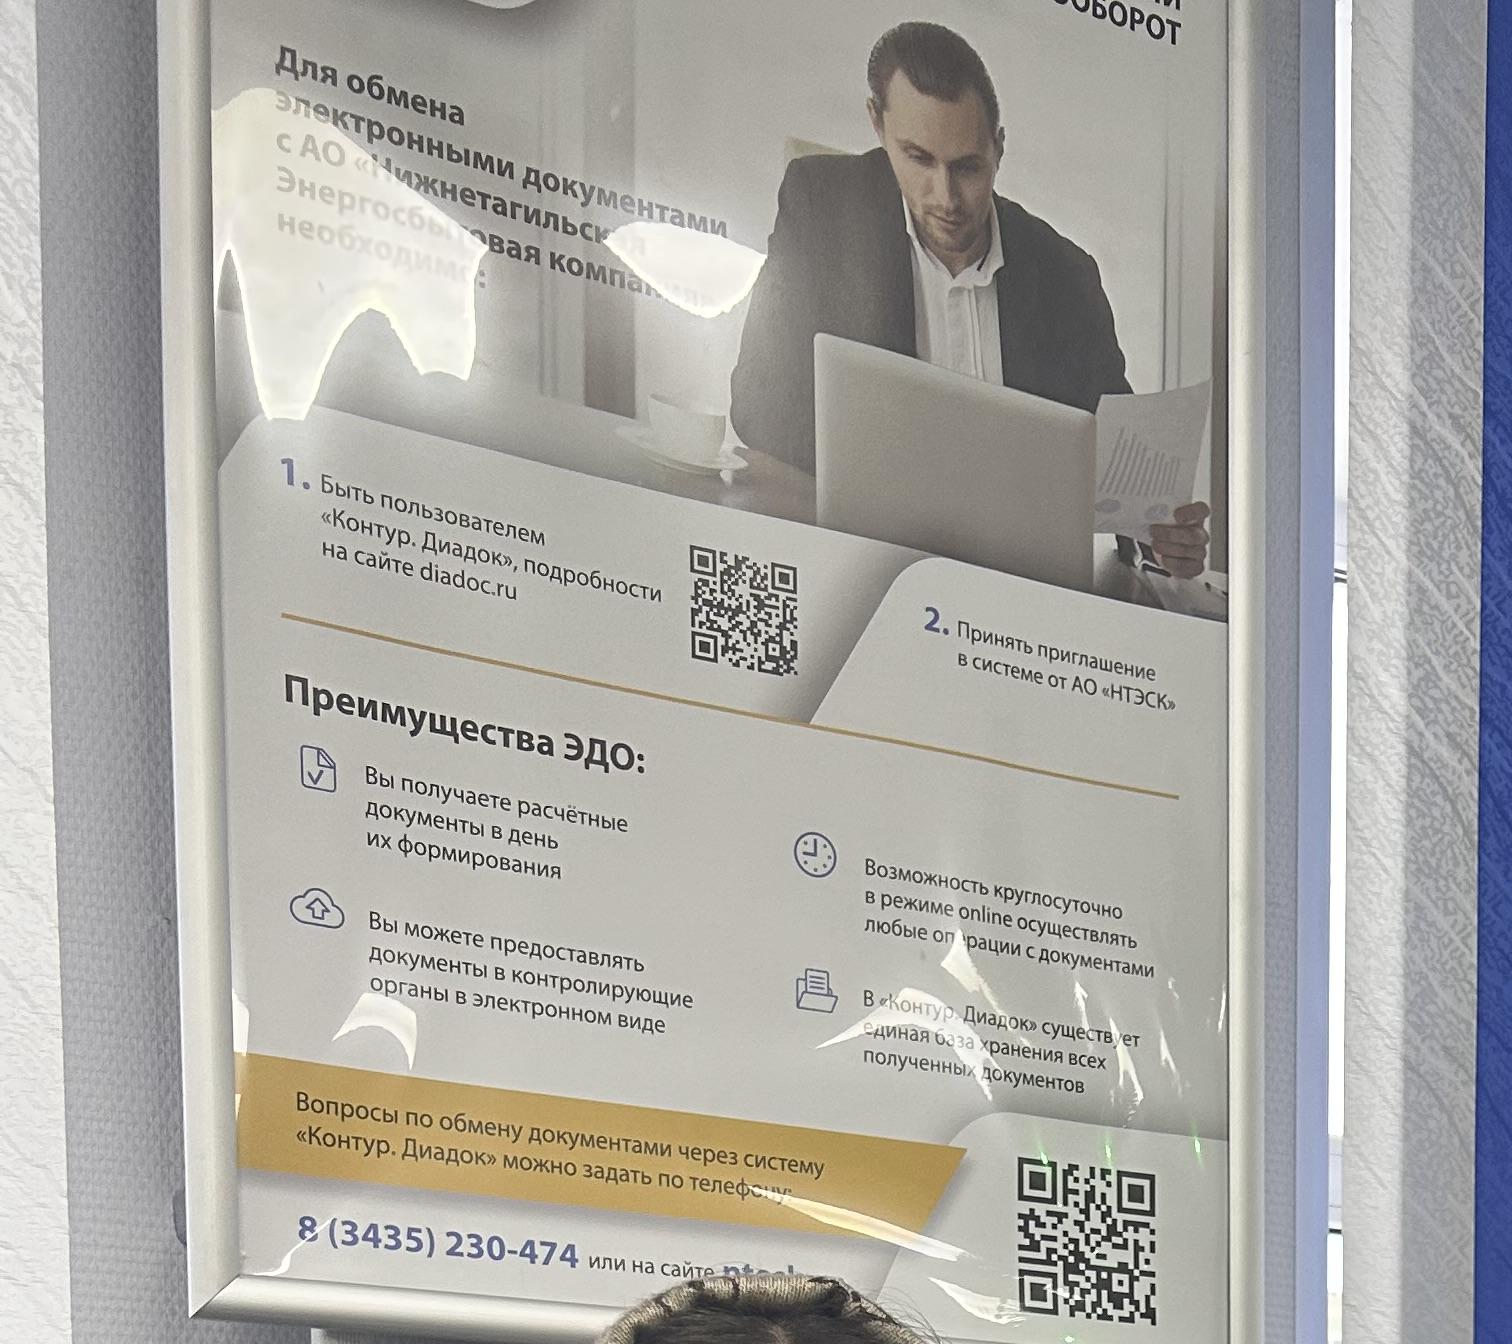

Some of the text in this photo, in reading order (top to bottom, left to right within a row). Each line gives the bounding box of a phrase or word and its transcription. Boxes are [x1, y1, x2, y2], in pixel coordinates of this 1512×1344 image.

[275, 45, 466, 126] Для обмена
[275, 90, 728, 239] электронными документами
[276, 132, 292, 154] с
[299, 133, 346, 167] АО
[276, 166, 540, 266] Энергосбыовая
[281, 458, 546, 546] 1. Быть пользователем
[321, 508, 663, 602] «Контур. Диадок», подробности
[322, 542, 517, 600] на сайте diadoc.ru
[924, 607, 1156, 681] 2. Принять приглашение
[958, 653, 1176, 711] в системе от АО «НТЭСК»
[284, 673, 645, 773] Преимущества ЭДО:
[365, 765, 628, 833] Вы получаете расчётные
[365, 800, 559, 849] документы в день
[367, 833, 562, 879] их формирования
[865, 858, 1123, 920] Возможность круглосуточно
[865, 891, 1138, 950] в режиме online осуществлять
[369, 911, 645, 973] Вы можете предоставлять
[864, 916, 1154, 979] любые опрации с документами
[369, 945, 693, 1009] документы в контролирующие
[370, 976, 665, 1034] органы в электронном виде
[864, 990, 874, 1007] В
[963, 1006, 1037, 1032] Диадок»
[1041, 1019, 1141, 1048] существует
[864, 1022, 1107, 1070] единая база хранения всех
[864, 1051, 1085, 1094] полученных документов
[296, 1092, 824, 1180] Вопросы по обмену документами через систему
[296, 1127, 396, 1158] «Контур.
[402, 1138, 496, 1167] Диадок»
[503, 1153, 577, 1176] можно
[583, 1162, 651, 1187] задать
[658, 1172, 684, 1190] по
[298, 1216, 319, 1242] 8
[329, 1217, 436, 1259] (3435)
[446, 1231, 580, 1269] 230-474
[589, 1256, 625, 1273] или
[632, 1258, 655, 1275] на
[661, 1261, 714, 1279] сайте
